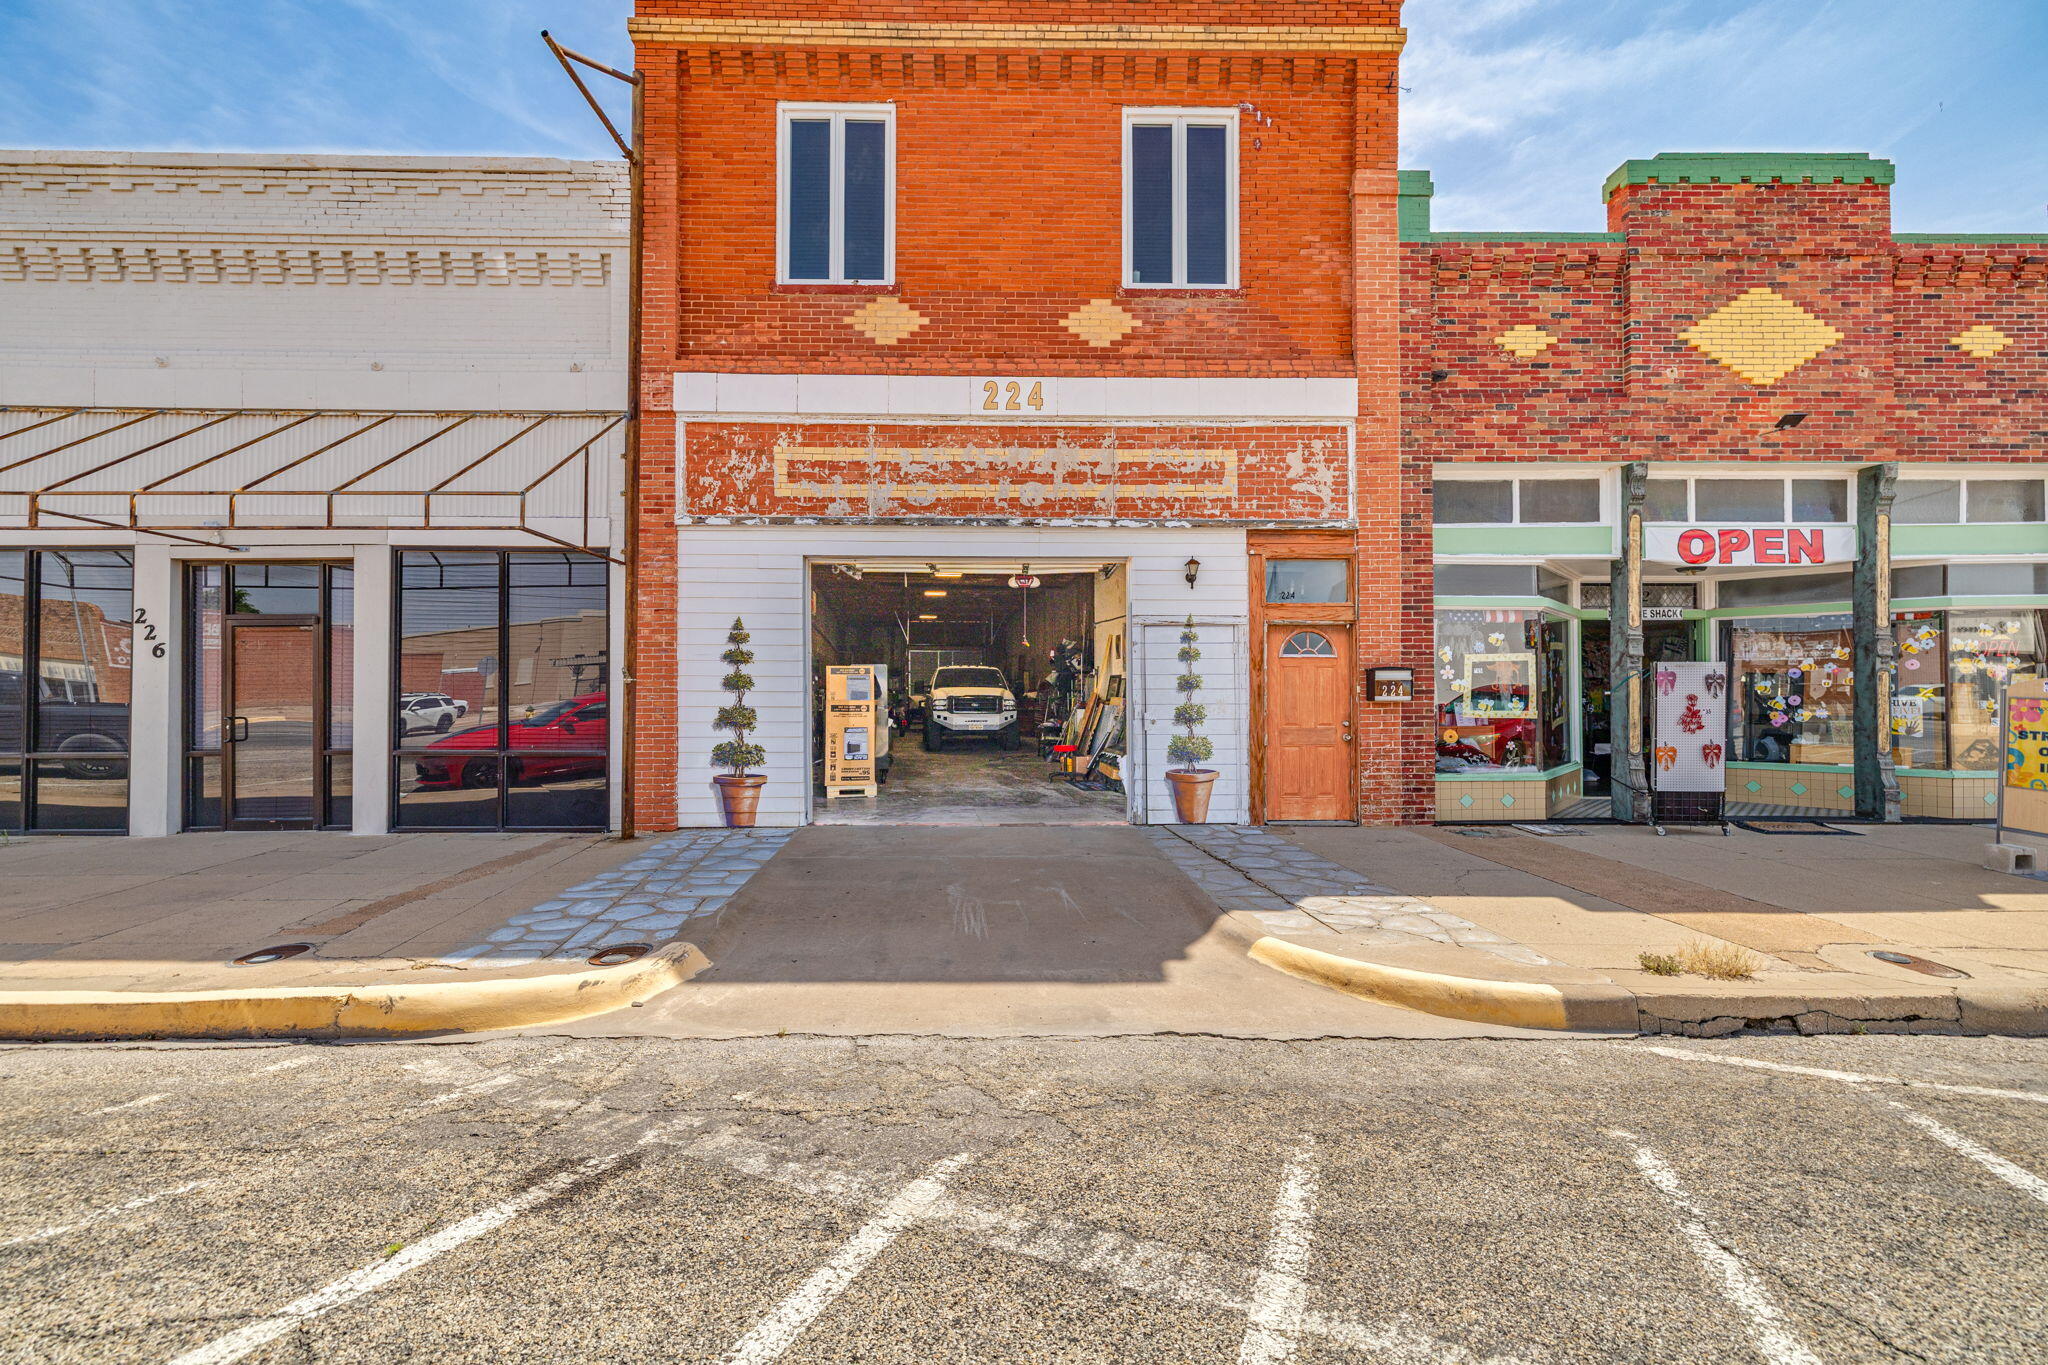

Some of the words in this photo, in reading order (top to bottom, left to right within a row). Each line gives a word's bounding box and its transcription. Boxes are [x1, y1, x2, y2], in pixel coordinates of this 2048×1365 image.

[982, 380, 1044, 411] 224
[1677, 528, 1825, 565] OPEN
[1649, 608, 1679, 619] SHACK
[134, 607, 167, 659] 226
[1977, 639, 2020, 657] OPEN
[1382, 685, 1404, 697] 224
